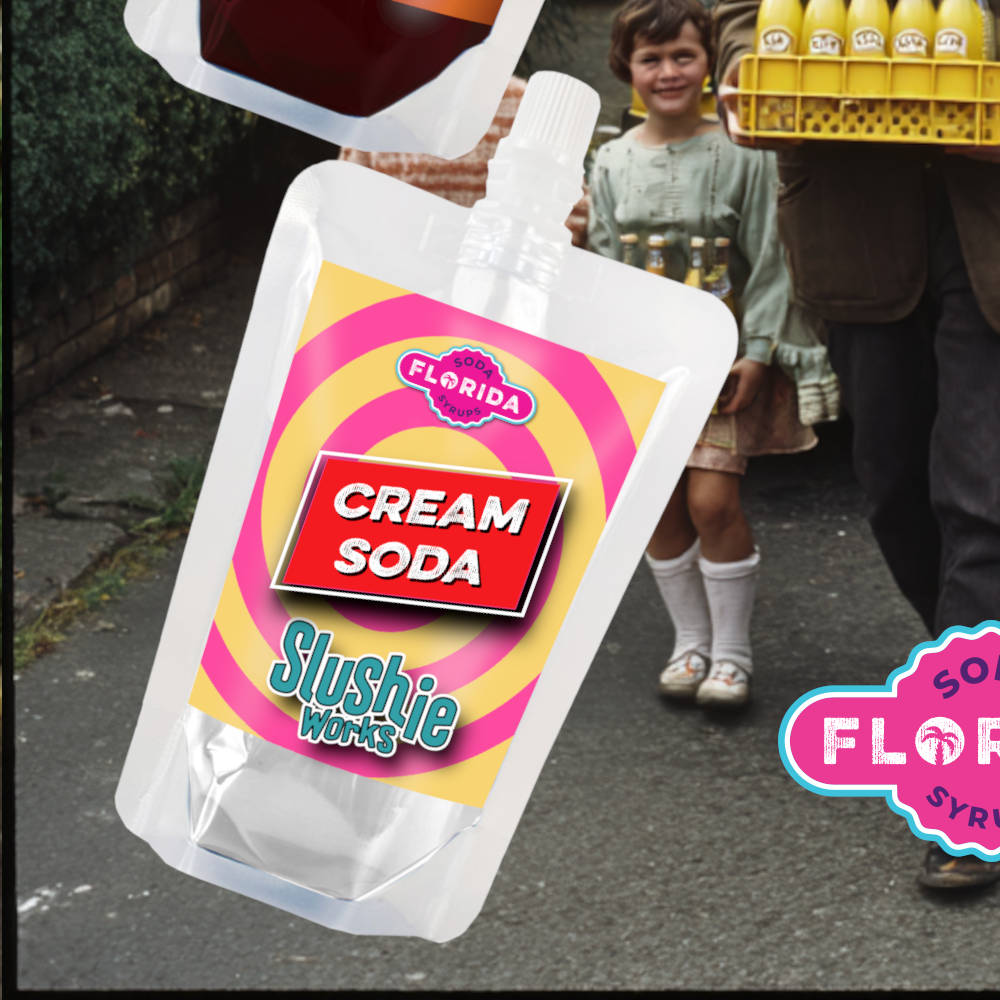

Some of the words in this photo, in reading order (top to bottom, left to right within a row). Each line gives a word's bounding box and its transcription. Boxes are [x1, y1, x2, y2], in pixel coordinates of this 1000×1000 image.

[408, 358, 521, 415] FLORIDA
[453, 356, 493, 380] SODA
[437, 394, 482, 418] SYRUPS
[333, 482, 530, 535] CREAM
[333, 537, 481, 587] SODA
